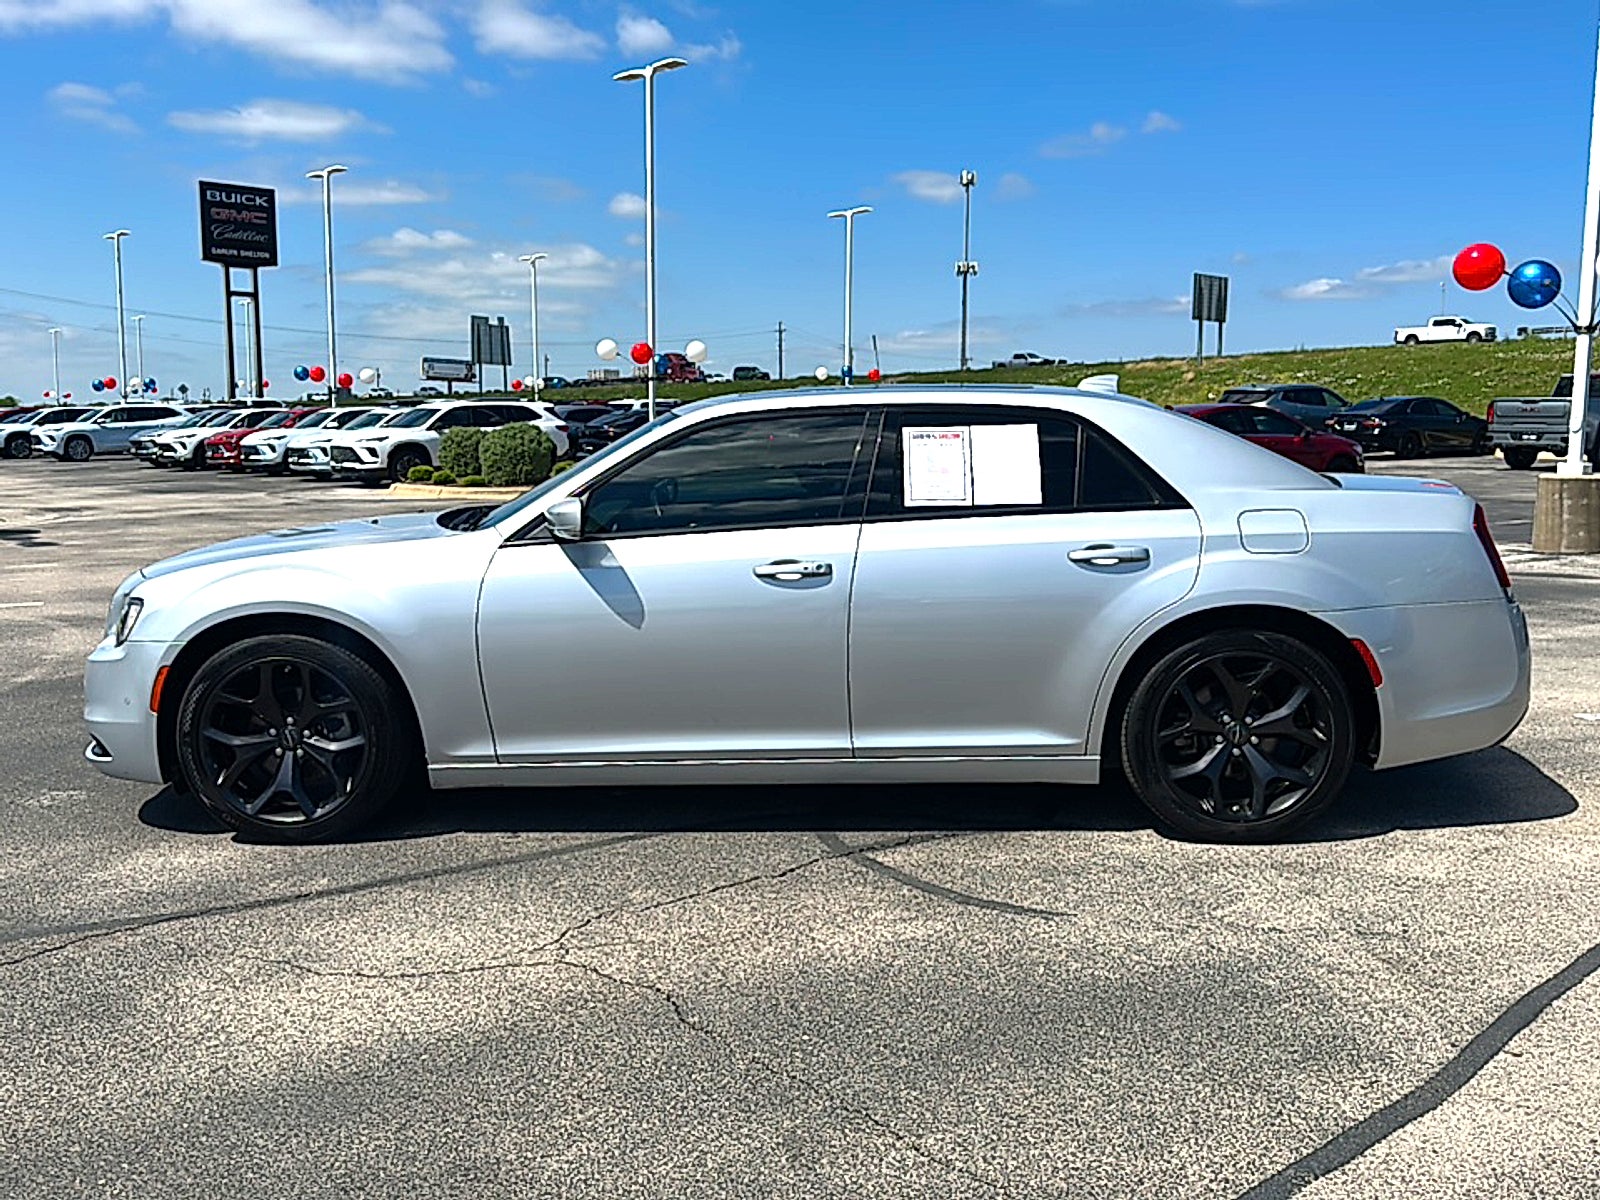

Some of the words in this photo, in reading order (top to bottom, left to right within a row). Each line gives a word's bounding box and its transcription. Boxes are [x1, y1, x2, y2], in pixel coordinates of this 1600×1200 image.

[206, 190, 269, 207] BUICK
[210, 207, 267, 224] GMC
[210, 223, 268, 243] Cadillac
